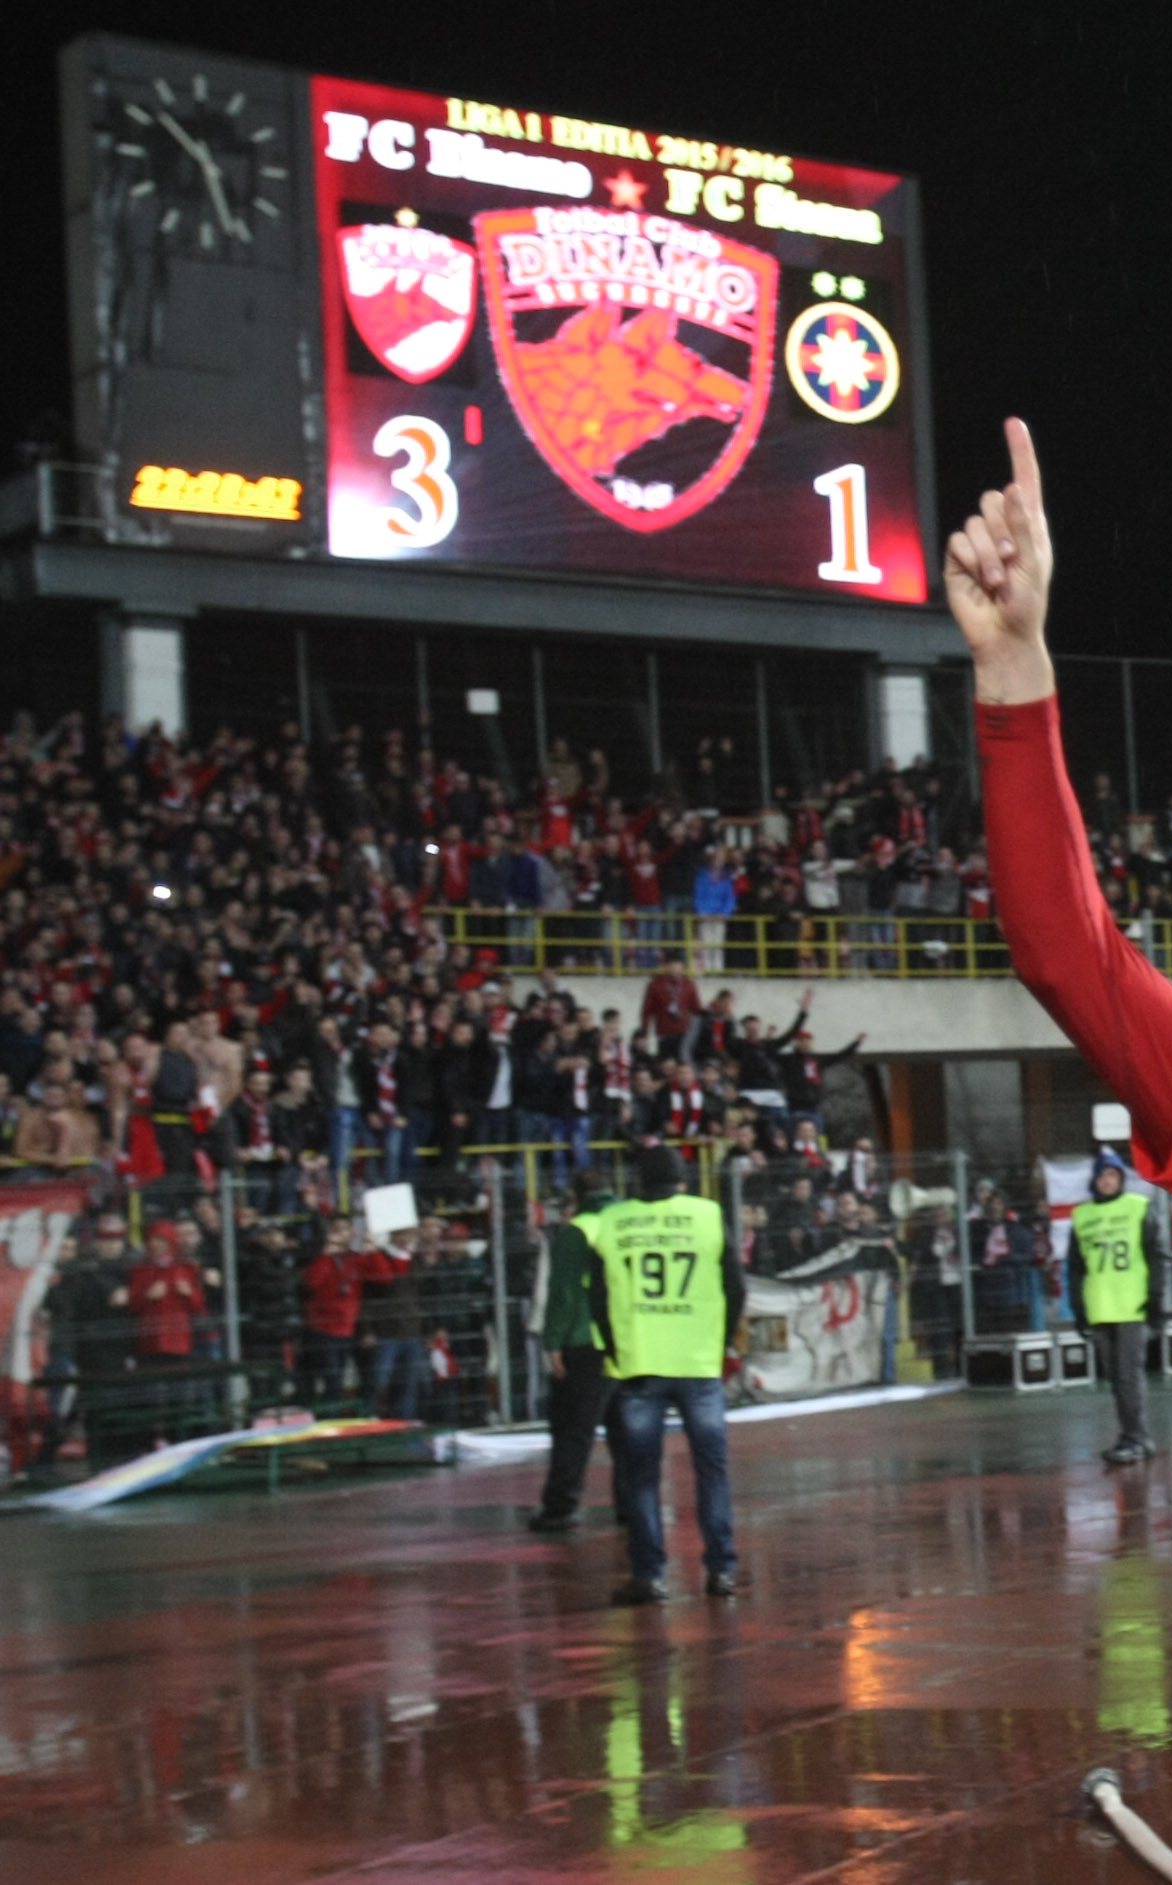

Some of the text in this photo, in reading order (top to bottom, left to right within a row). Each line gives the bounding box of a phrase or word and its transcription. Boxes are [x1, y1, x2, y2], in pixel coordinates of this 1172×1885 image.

[322, 111, 416, 171] FC
[445, 97, 525, 140] LIGA
[550, 115, 653, 161] EDITIA
[663, 168, 745, 222] FC
[499, 233, 758, 313] DINAMO
[373, 414, 458, 549] 3
[813, 463, 883, 584] 1
[1092, 1240, 1130, 1274] 78
